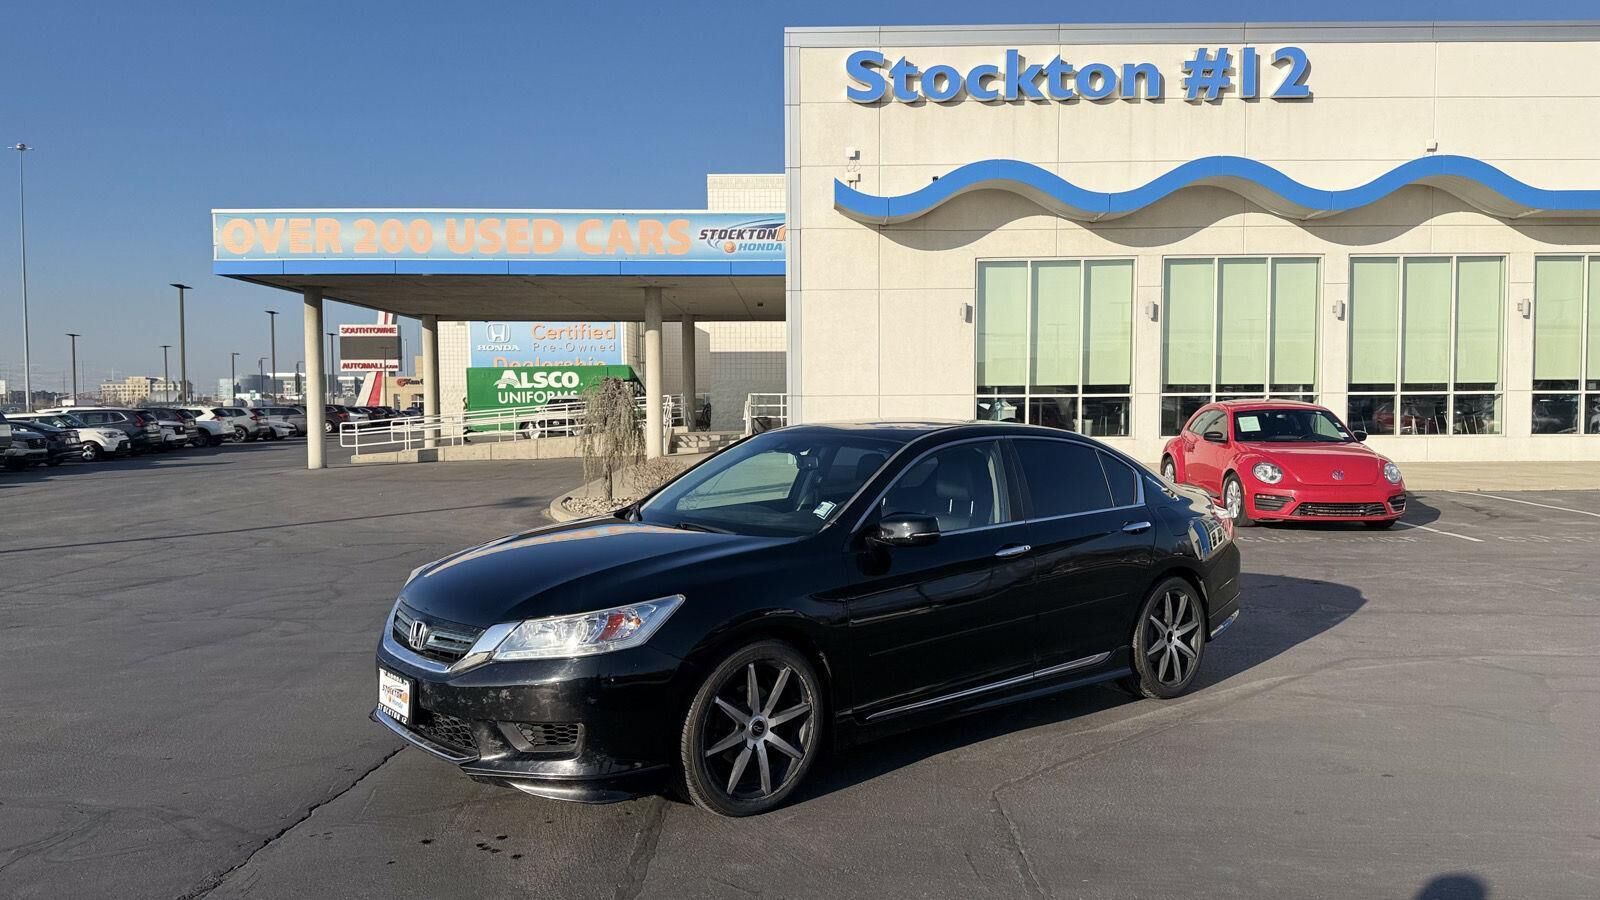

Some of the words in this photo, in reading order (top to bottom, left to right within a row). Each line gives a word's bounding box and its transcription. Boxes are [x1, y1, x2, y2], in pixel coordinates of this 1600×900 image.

[845, 49, 1161, 103] Stockton
[1183, 46, 1311, 101] #12
[222, 218, 342, 254] OVER
[352, 218, 433, 254] 200
[445, 218, 564, 254] USED
[575, 219, 692, 255] CARS
[738, 243, 782, 251] HONDA
[531, 322, 616, 341] Certified
[477, 344, 520, 352] HONDA
[533, 342, 616, 352] Pre-Owned
